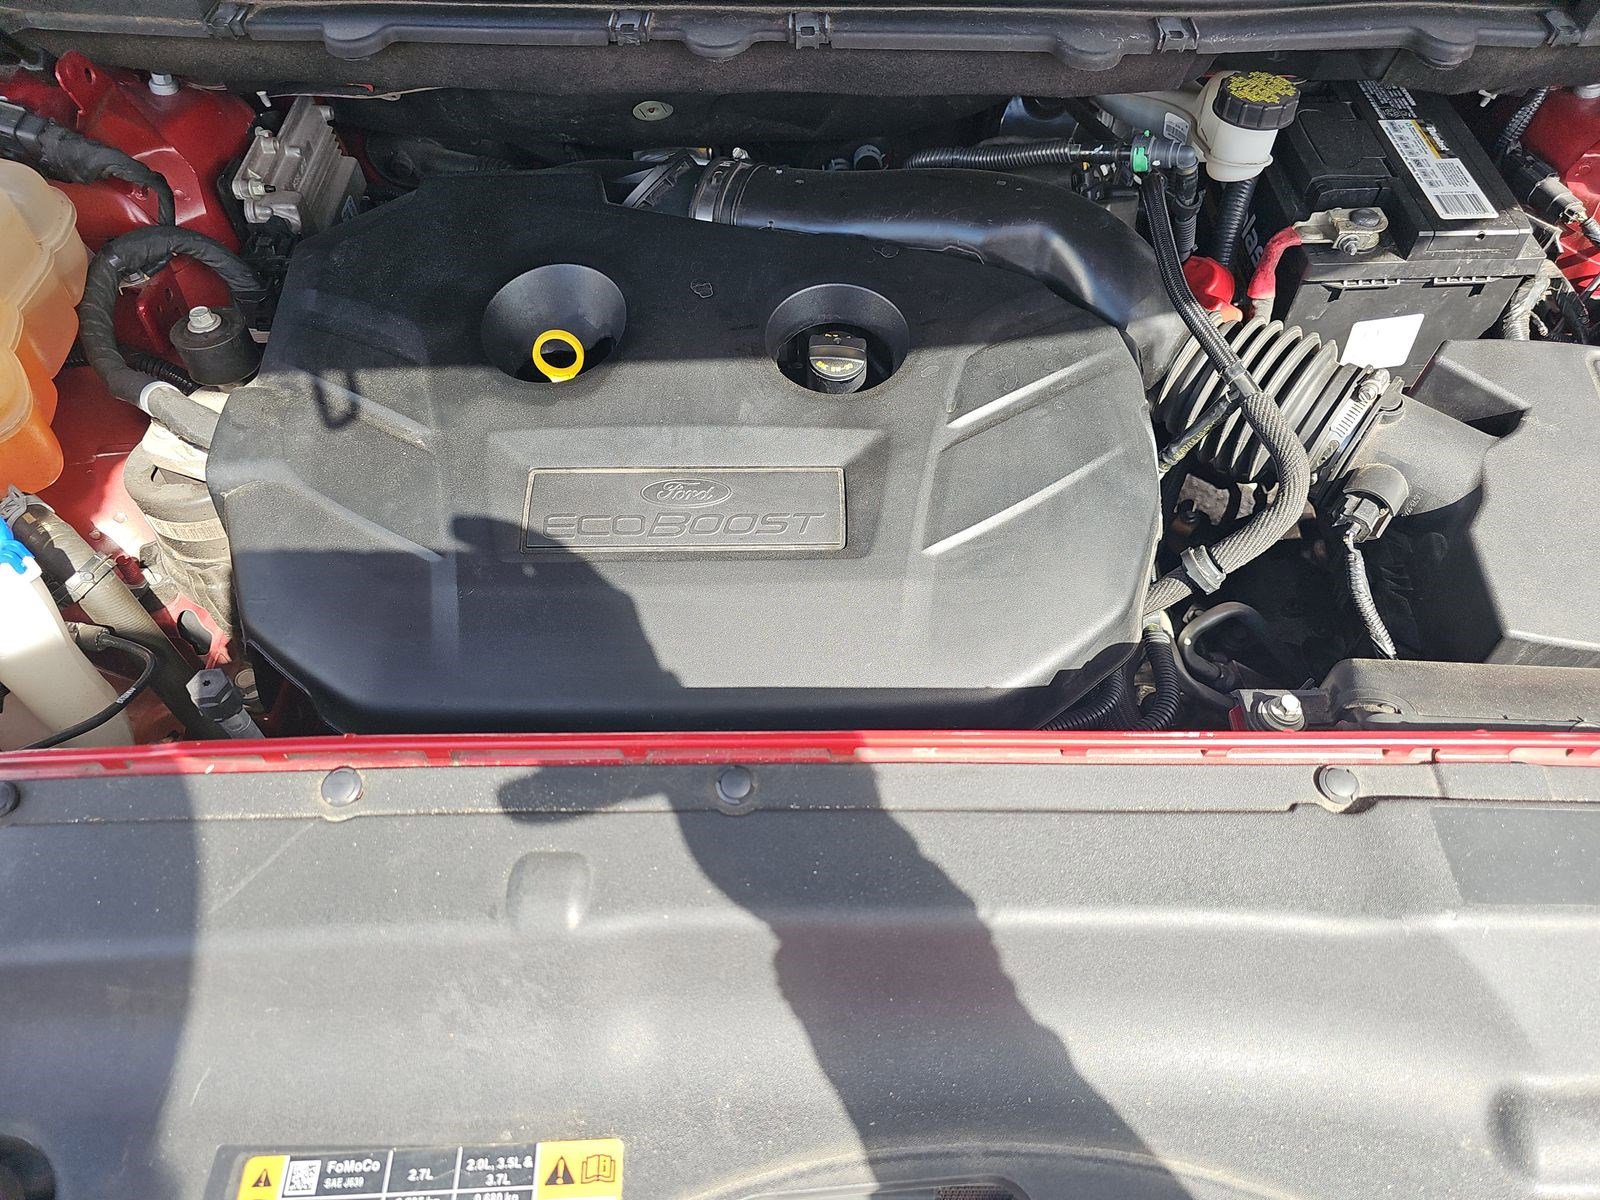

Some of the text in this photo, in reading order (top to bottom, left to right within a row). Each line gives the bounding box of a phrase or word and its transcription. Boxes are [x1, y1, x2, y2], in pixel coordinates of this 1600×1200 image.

[655, 480, 714, 501] Ford
[542, 511, 826, 540] ECOBOOST
[326, 1158, 381, 1175] FoMoCo
[466, 1155, 534, 1171] 2.0L, 3.5L &
[408, 1168, 433, 1181] 2.7L
[485, 1173, 511, 1186] 3.7L
[323, 1178, 343, 1189] SAE
